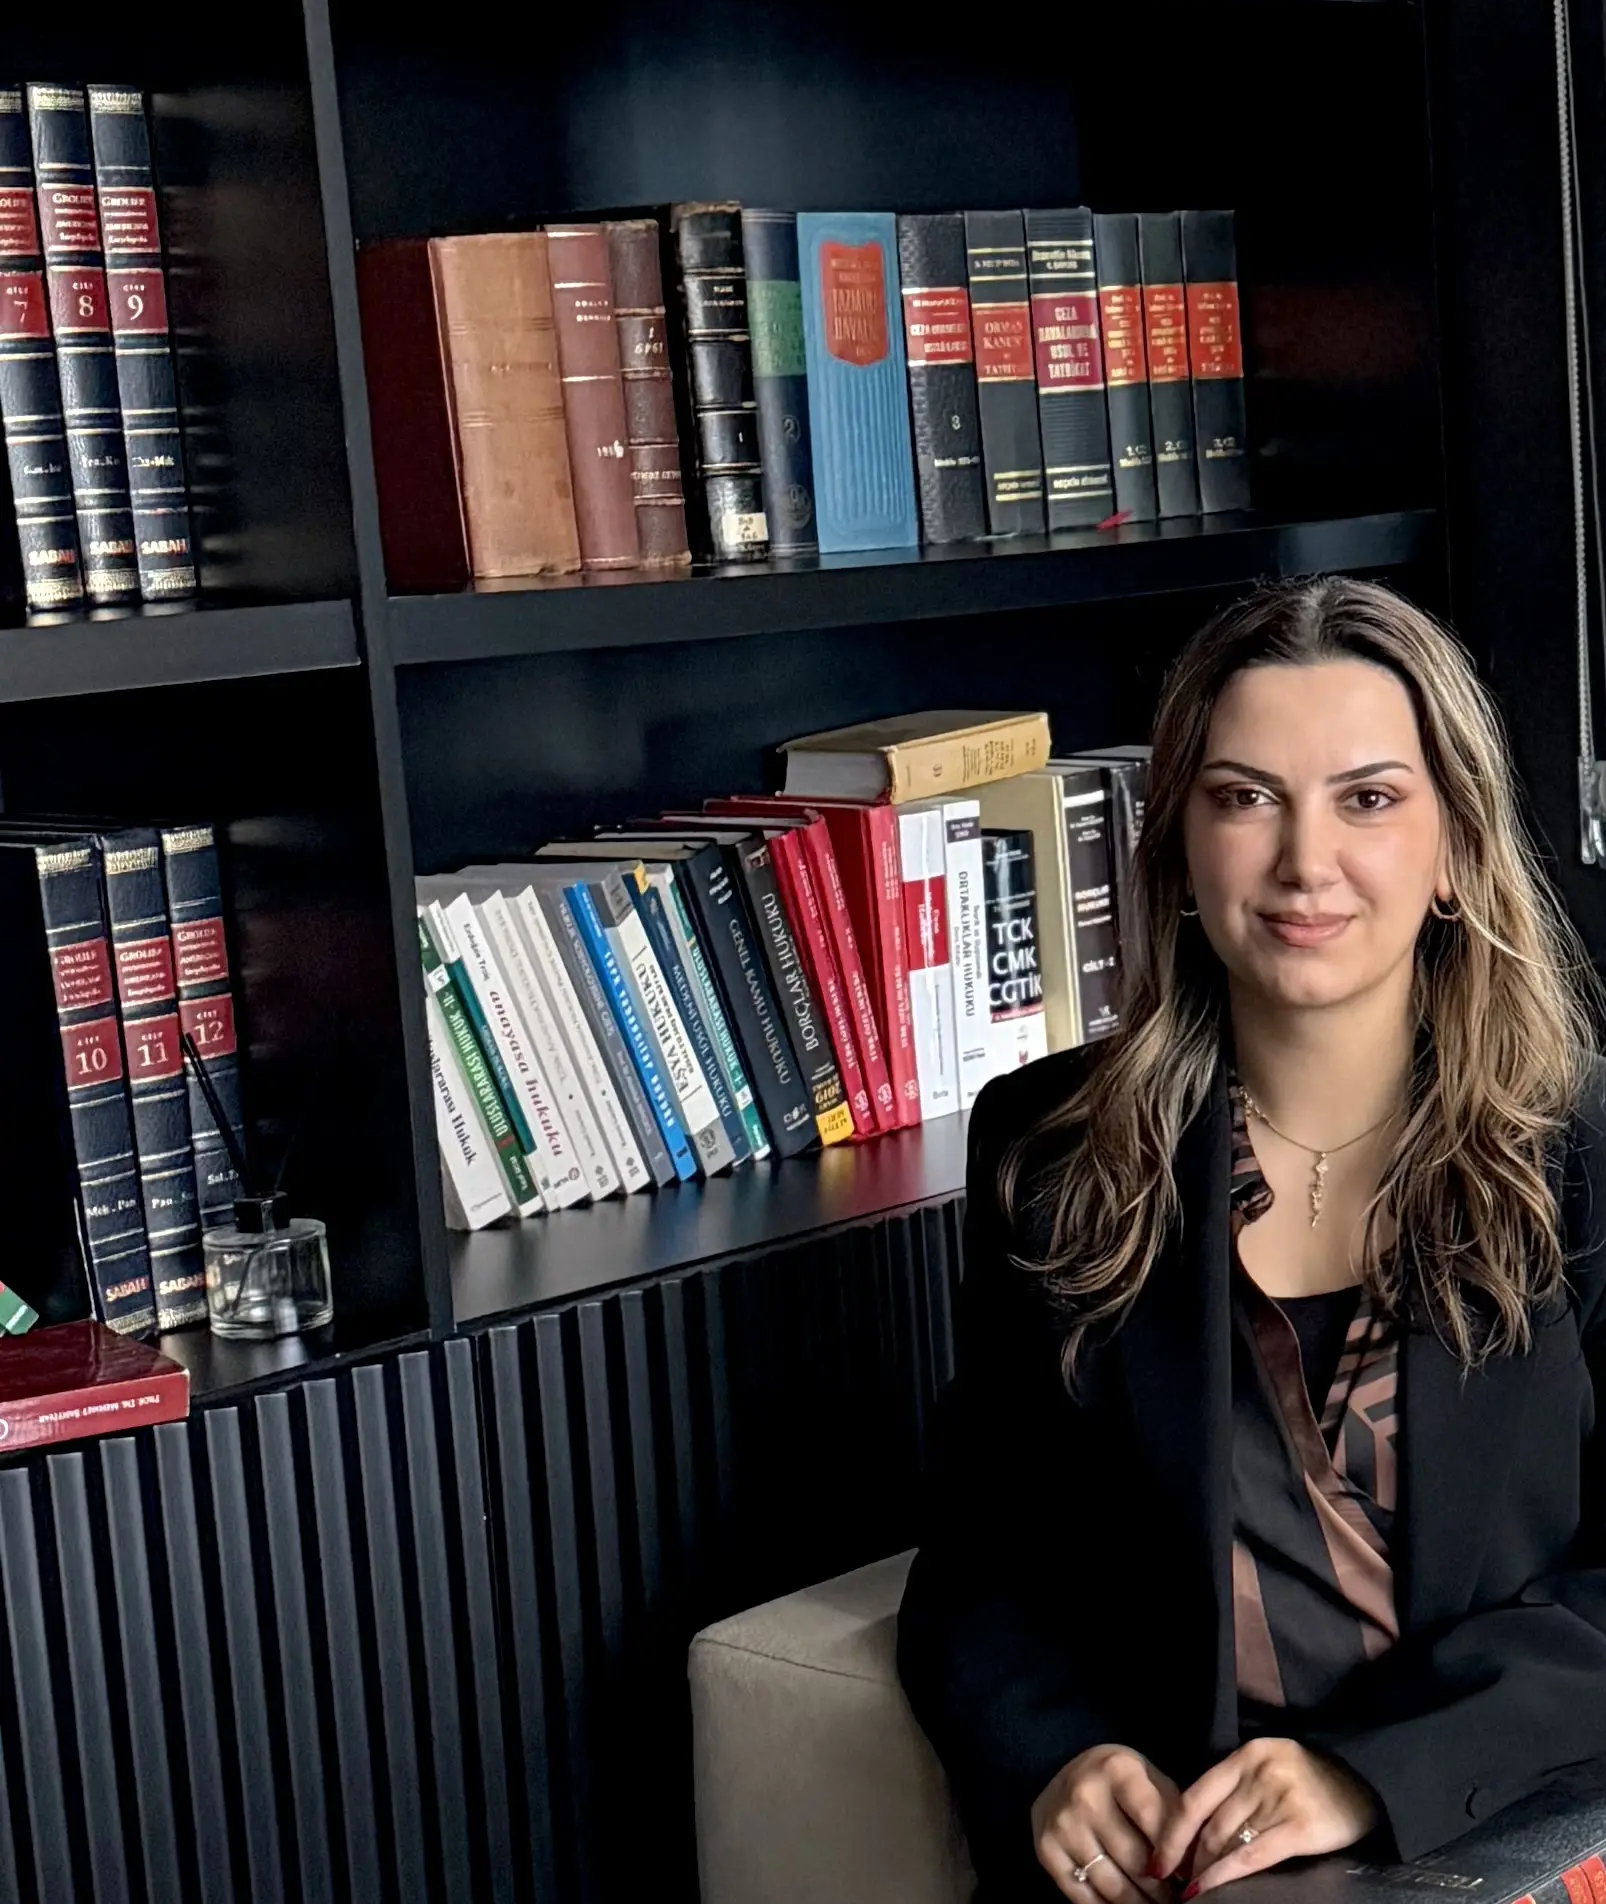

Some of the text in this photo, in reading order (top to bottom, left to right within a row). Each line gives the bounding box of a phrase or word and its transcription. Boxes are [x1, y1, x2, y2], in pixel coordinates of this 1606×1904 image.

[78, 294, 95, 318] 8
[127, 294, 144, 321] 9
[1054, 306, 1078, 321] CEZA
[140, 537, 190, 556] SABAH
[957, 870, 976, 1017] ORTAKLIKLAR HUKUKU
[992, 916, 1034, 945] TCK
[762, 892, 820, 1051] BORÇLAR HUKUKU
[992, 946, 1038, 976] CMK
[691, 945, 728, 1030] ULUSLARARASI
[719, 1029, 740, 1069] HUKUK
[728, 919, 791, 1085] GENEL KAMU HUKUKU
[193, 1020, 225, 1046] 12
[450, 1010, 469, 1051] HUKUK
[636, 963, 690, 1096] EŞYA HUKUKU
[75, 1046, 108, 1076] 10
[137, 1041, 169, 1068] 11
[489, 990, 563, 1157] anayasa hukuku
[702, 1053, 733, 1117] HUKUKU
[465, 1048, 509, 1138] ULUSLARARASI
[451, 1114, 477, 1166] Hukuk
[106, 1276, 150, 1303] SABAH
